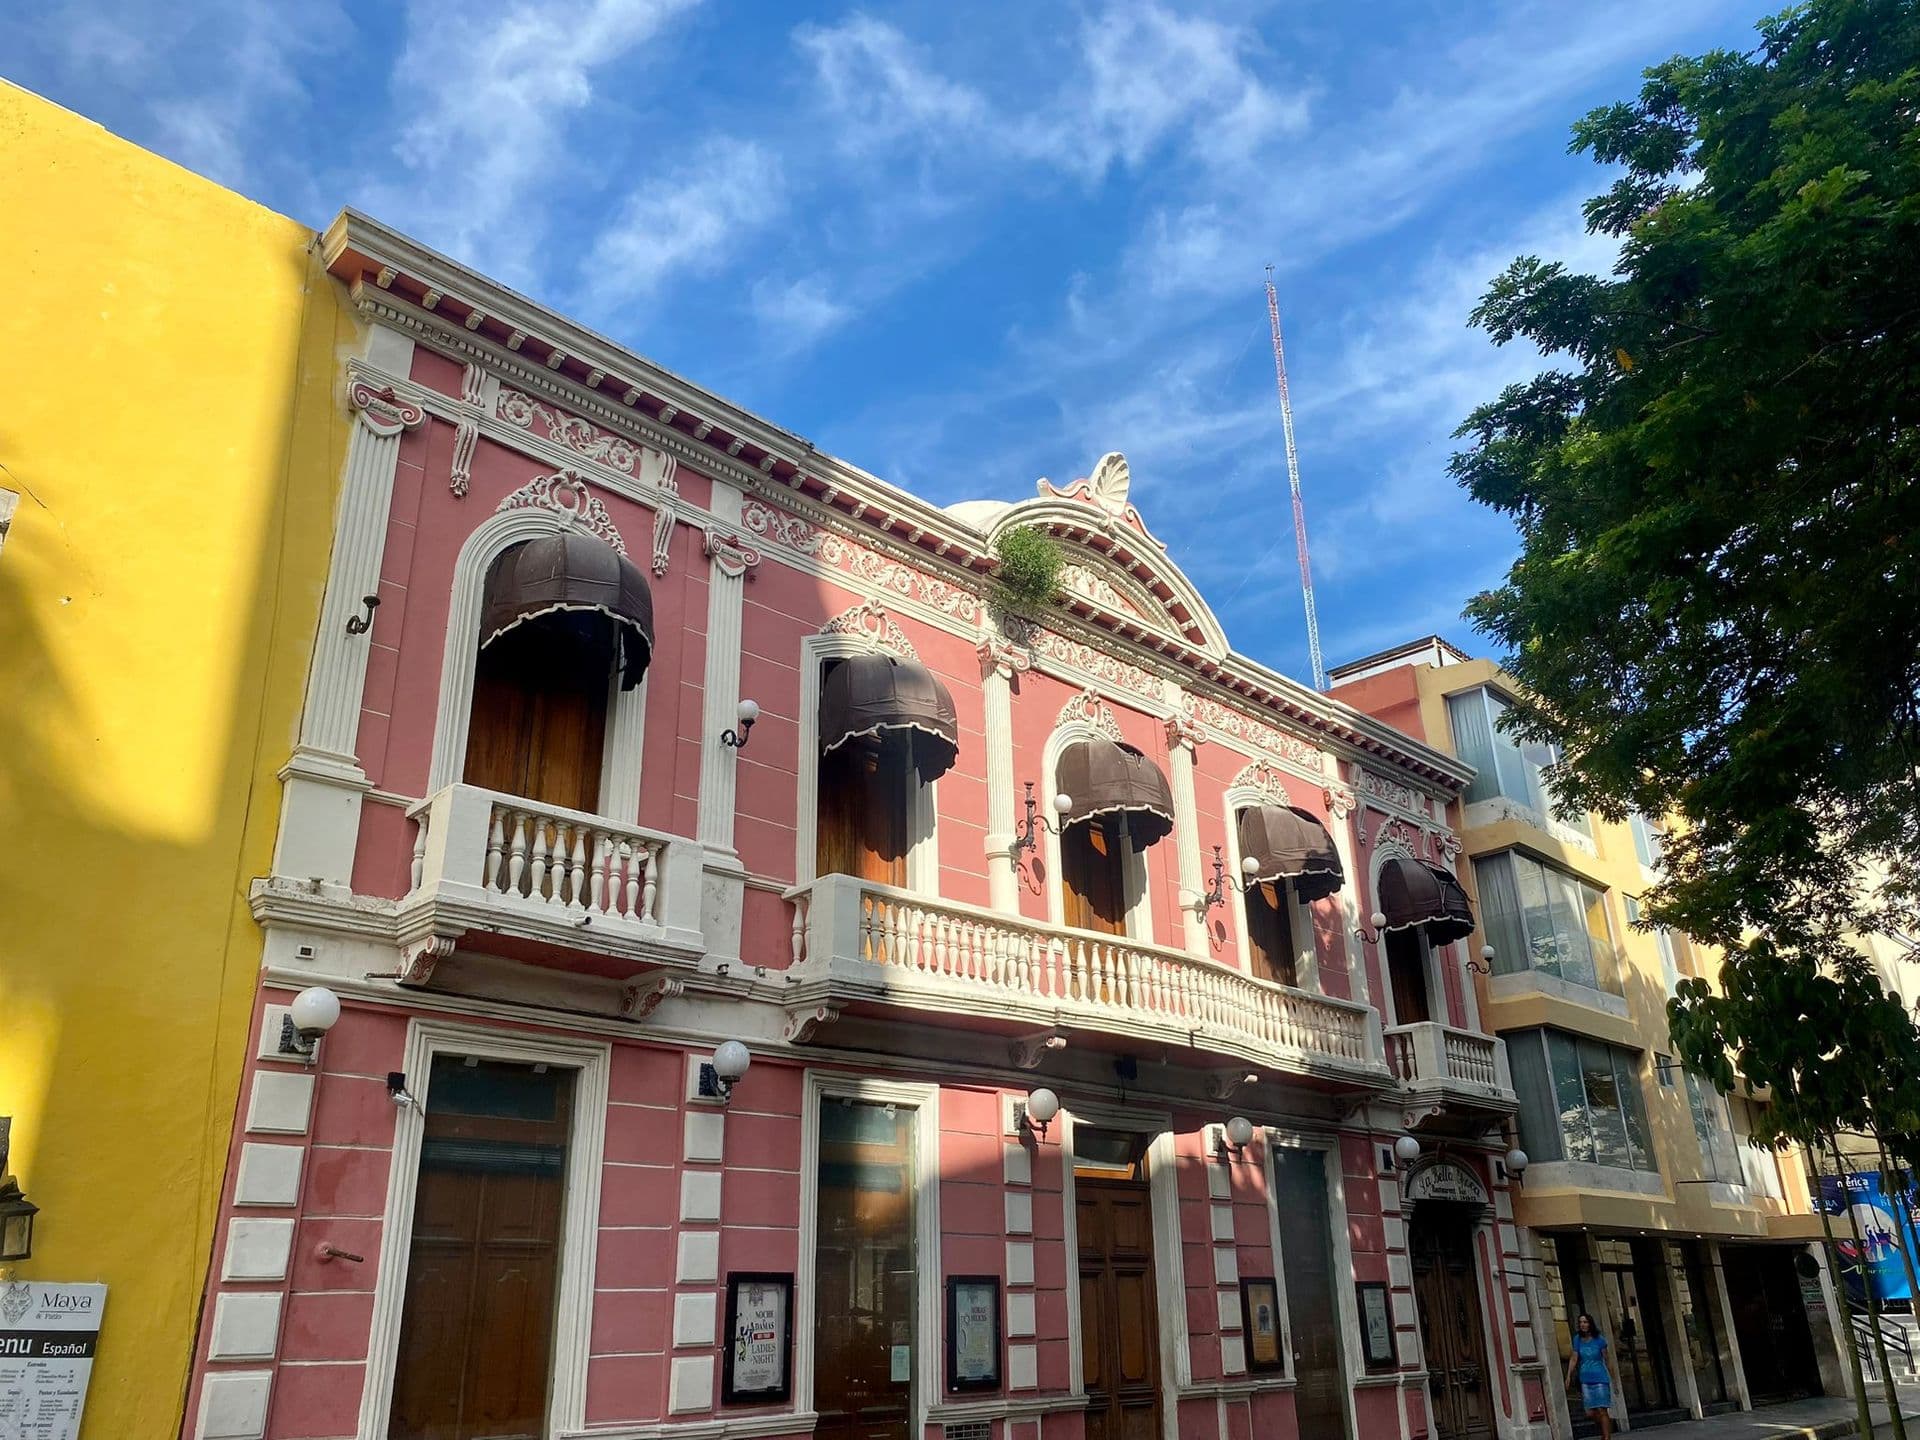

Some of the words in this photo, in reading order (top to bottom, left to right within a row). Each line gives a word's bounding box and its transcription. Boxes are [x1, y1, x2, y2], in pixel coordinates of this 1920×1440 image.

[41, 1292, 92, 1311] Maya
[755, 1310, 774, 1319] NOCHE
[754, 1321, 775, 1330] DAMAS
[0, 1337, 32, 1354] enu
[42, 1342, 87, 1356] Español
[751, 1343, 776, 1354] LADIES
[752, 1354, 775, 1365] NIGHT
